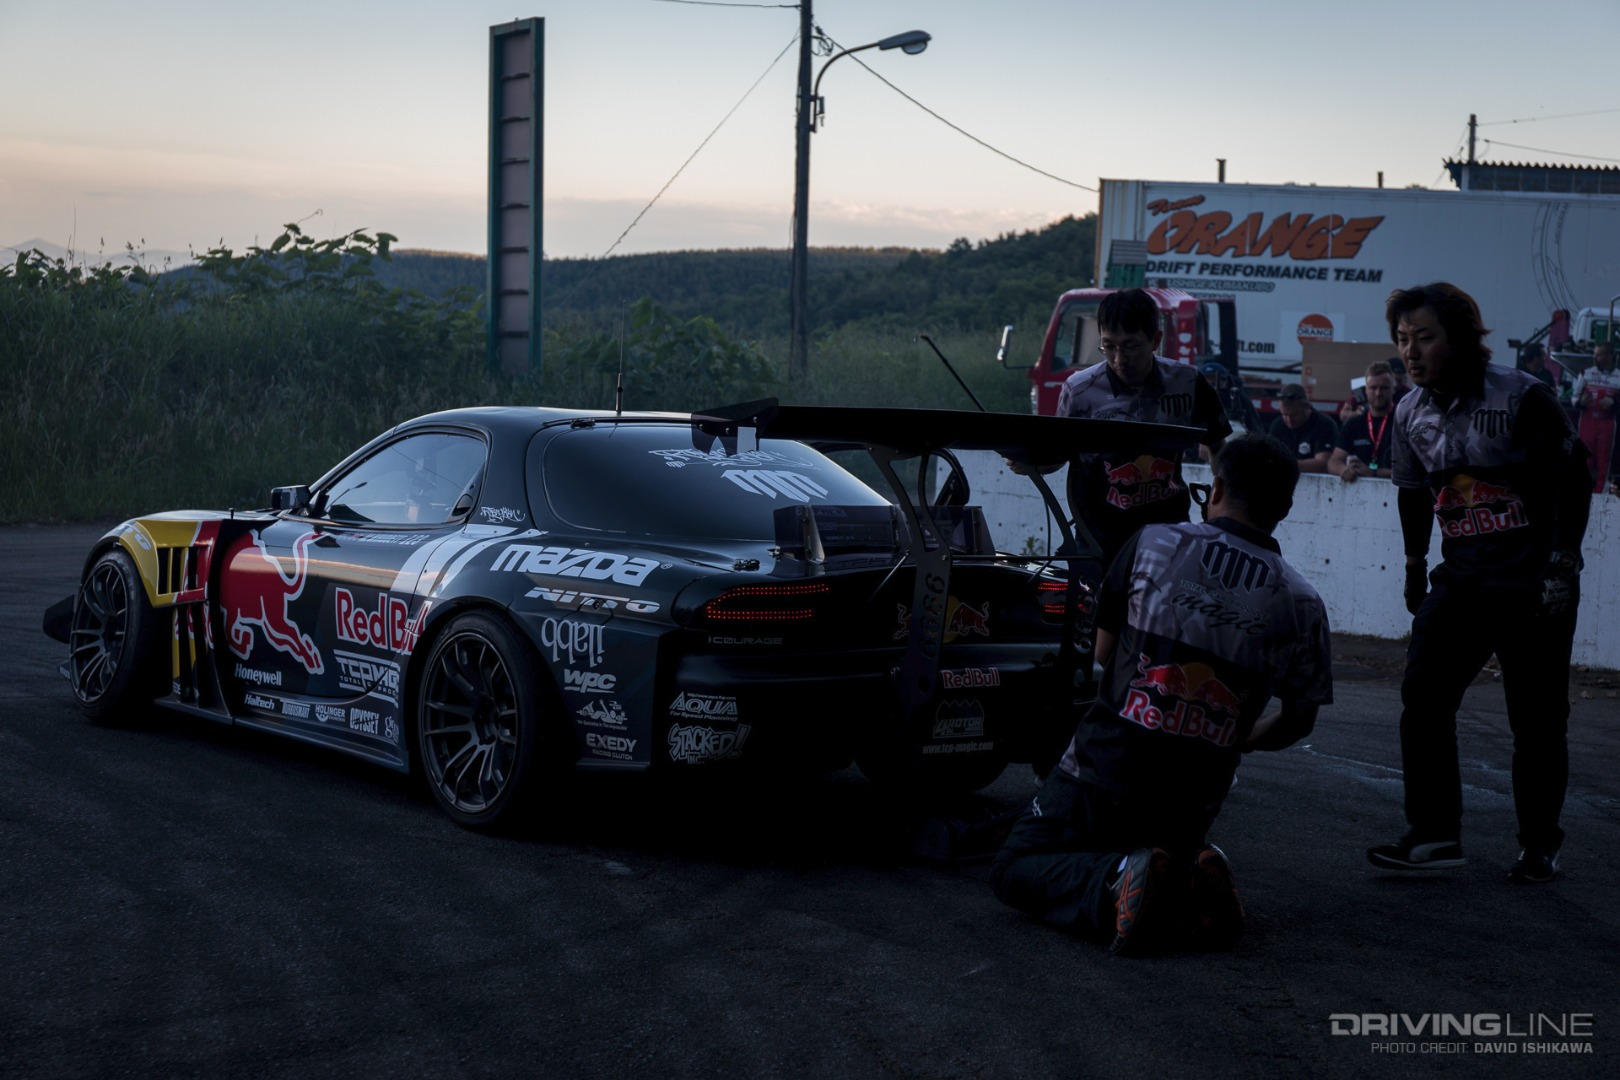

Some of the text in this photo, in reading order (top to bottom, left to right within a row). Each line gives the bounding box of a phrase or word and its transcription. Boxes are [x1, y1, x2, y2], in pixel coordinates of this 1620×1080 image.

[1147, 210, 1385, 260] ORANGE
[1146, 261, 1383, 283] DRIFT PERFORMANCE TEAM
[1297, 327, 1334, 337] ORANGE
[1473, 499, 1530, 534] Bull
[524, 586, 661, 613] NITTO
[335, 586, 389, 650] Red
[234, 663, 282, 687] Honeywell
[940, 667, 1001, 689] Red Bull
[244, 693, 275, 711] Haltech
[315, 704, 346, 719] HOLINGER
[668, 691, 738, 716] AQUA
[1119, 687, 1186, 735] Red
[585, 732, 637, 753] EXEDY
